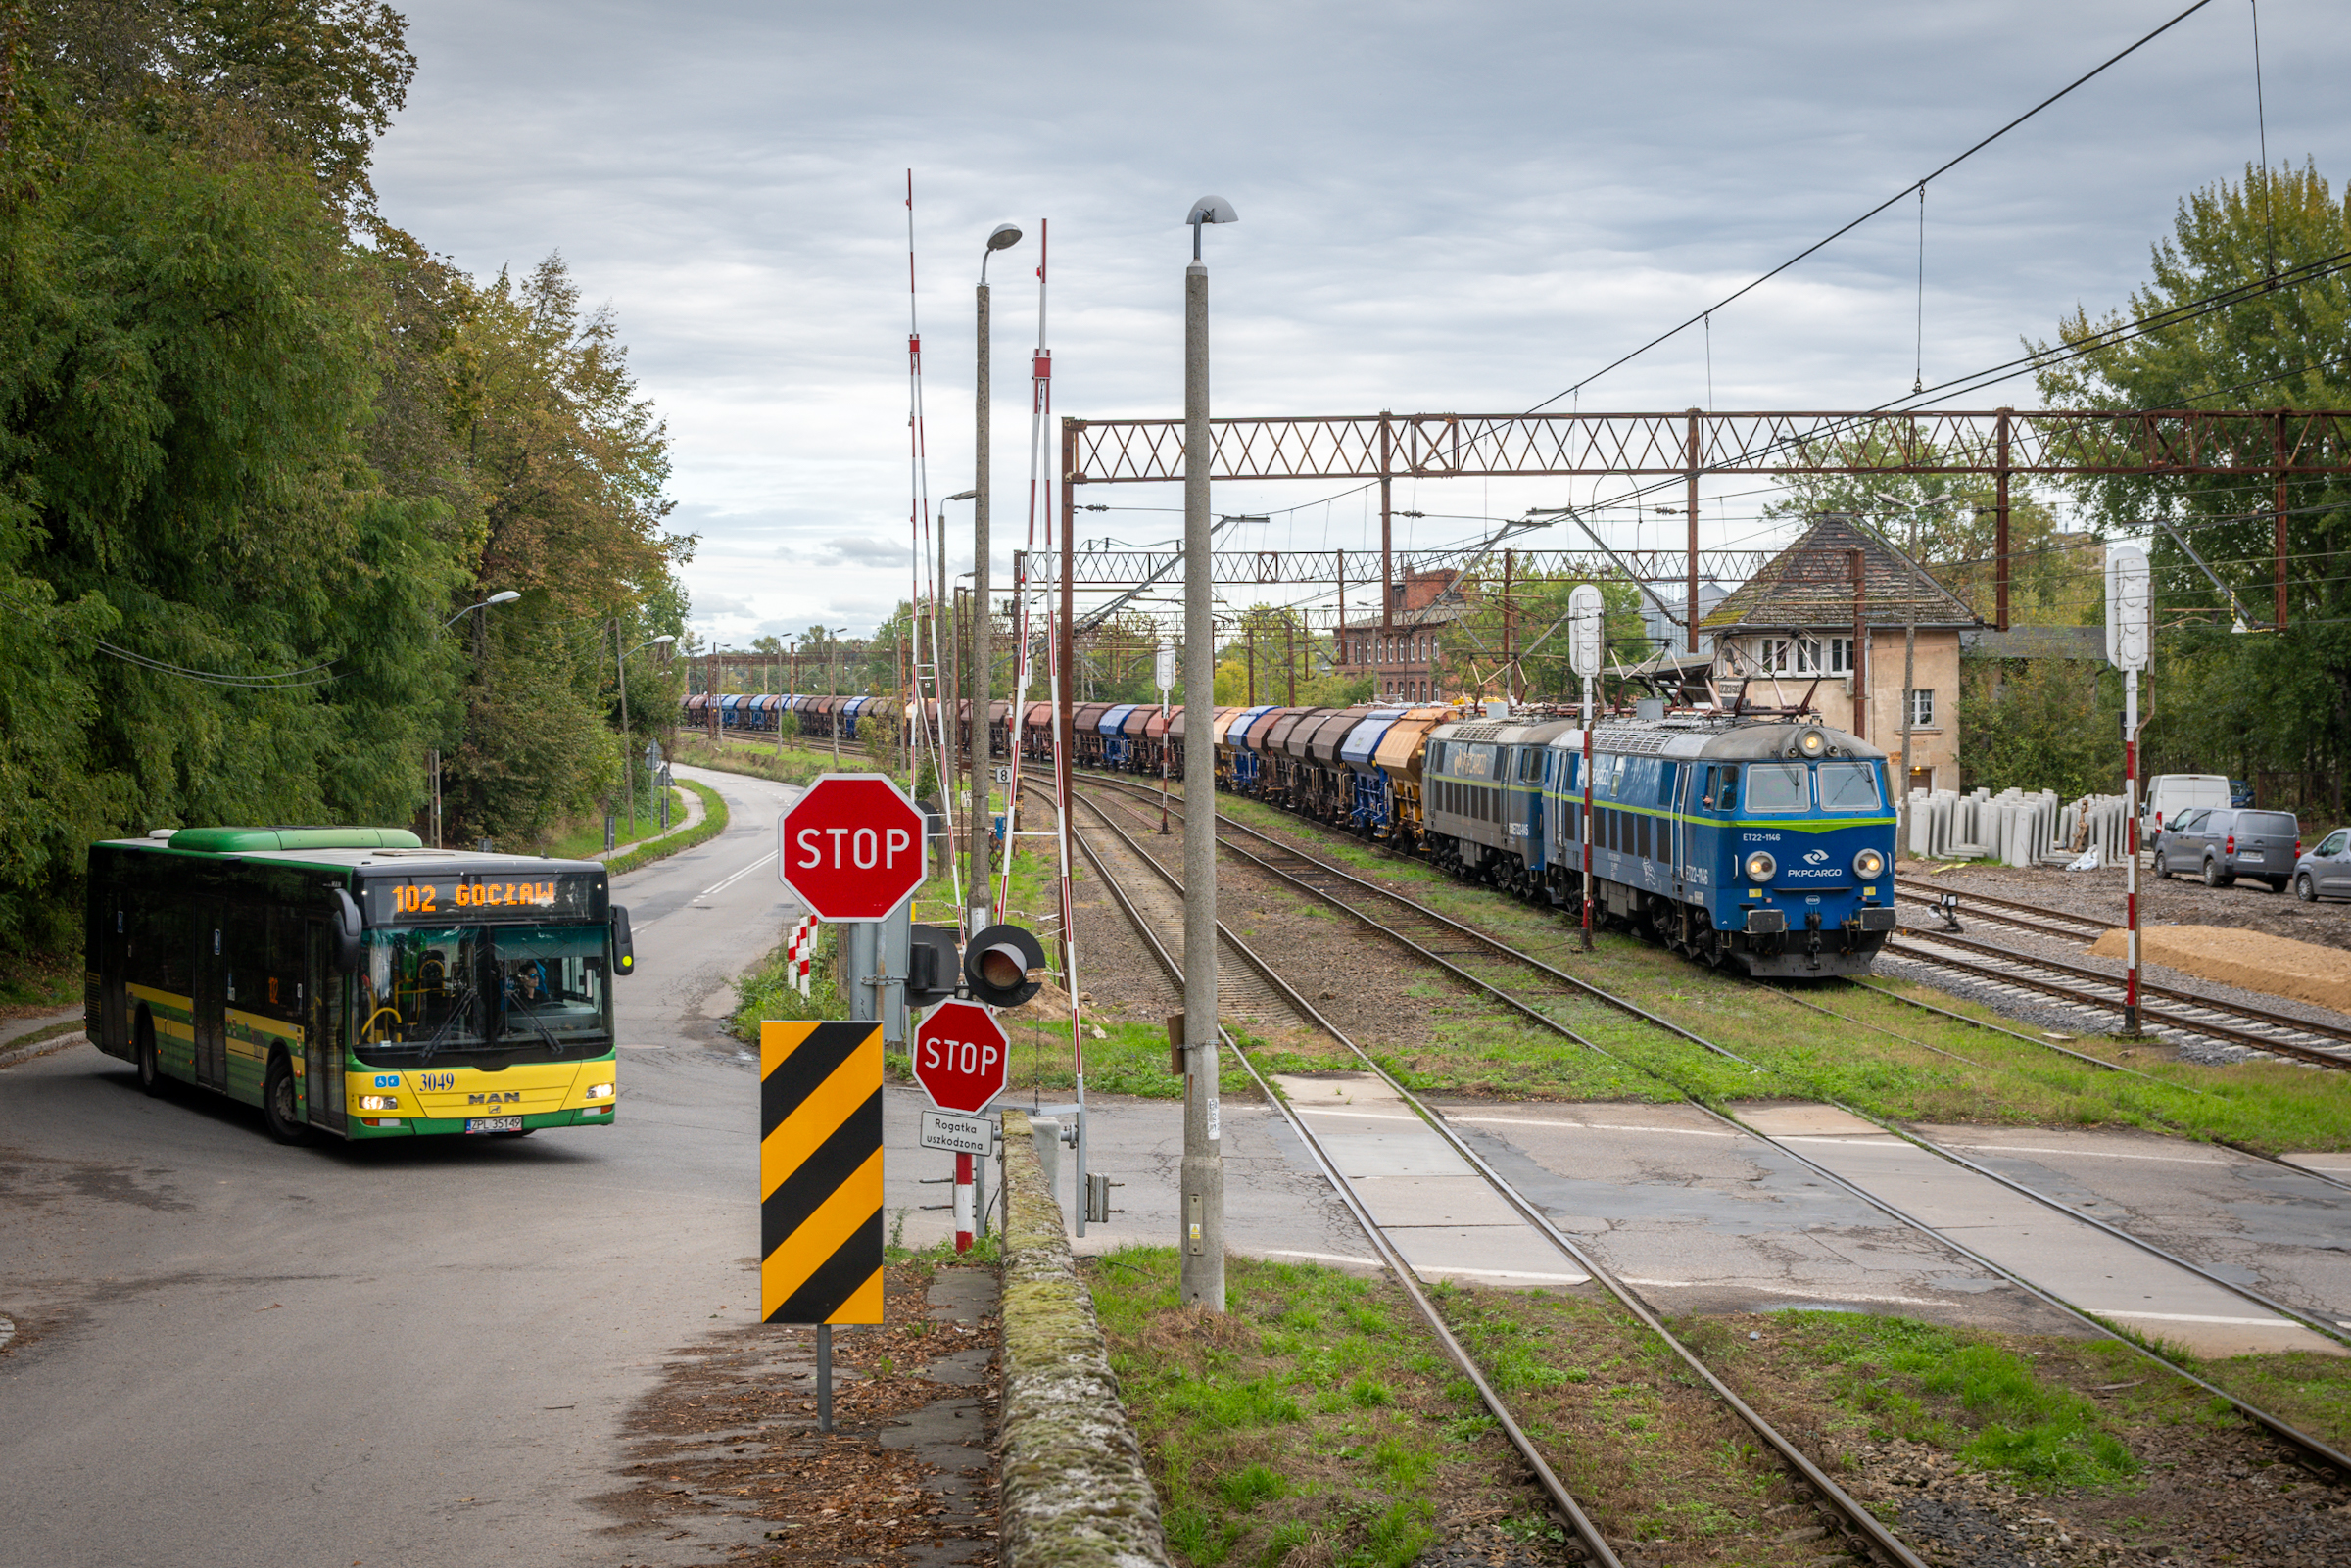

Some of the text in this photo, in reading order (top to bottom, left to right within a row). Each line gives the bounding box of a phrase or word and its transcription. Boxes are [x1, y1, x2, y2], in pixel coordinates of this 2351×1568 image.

[1000, 769, 1008, 782] 8
[1743, 833, 1782, 842] ET22-1146
[796, 827, 911, 870] STOP
[1787, 868, 1843, 878] PKPCARGO
[392, 882, 555, 913] 102 GOCŁAW
[924, 1036, 998, 1077] STOP
[418, 1072, 455, 1092] 3049
[468, 1091, 520, 1106] MAN
[471, 1117, 521, 1130] ZPL 35149
[935, 1118, 978, 1135] Rogatka
[926, 1134, 984, 1151] uszkodzona
